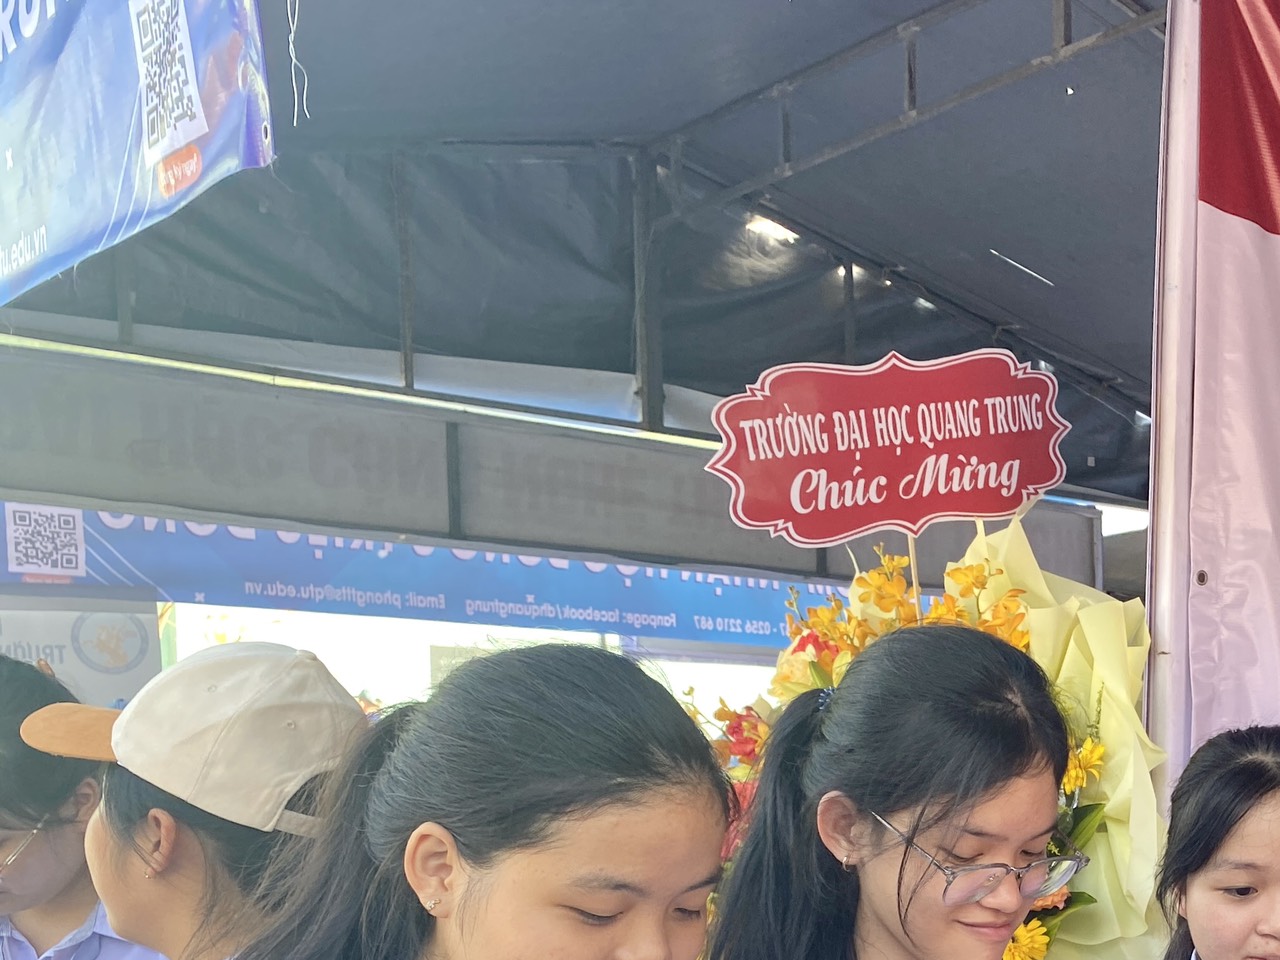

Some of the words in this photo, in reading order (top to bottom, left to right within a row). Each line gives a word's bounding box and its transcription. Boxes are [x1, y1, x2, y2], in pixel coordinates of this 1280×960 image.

[740, 403, 829, 461] TRƯỜNG
[832, 408, 870, 460] ĐẠI
[872, 407, 914, 455] HỌC
[917, 398, 981, 448] QUANG
[984, 393, 1043, 434] TRUNG
[790, 465, 887, 514] Chúc
[900, 453, 1020, 499] Mừng
